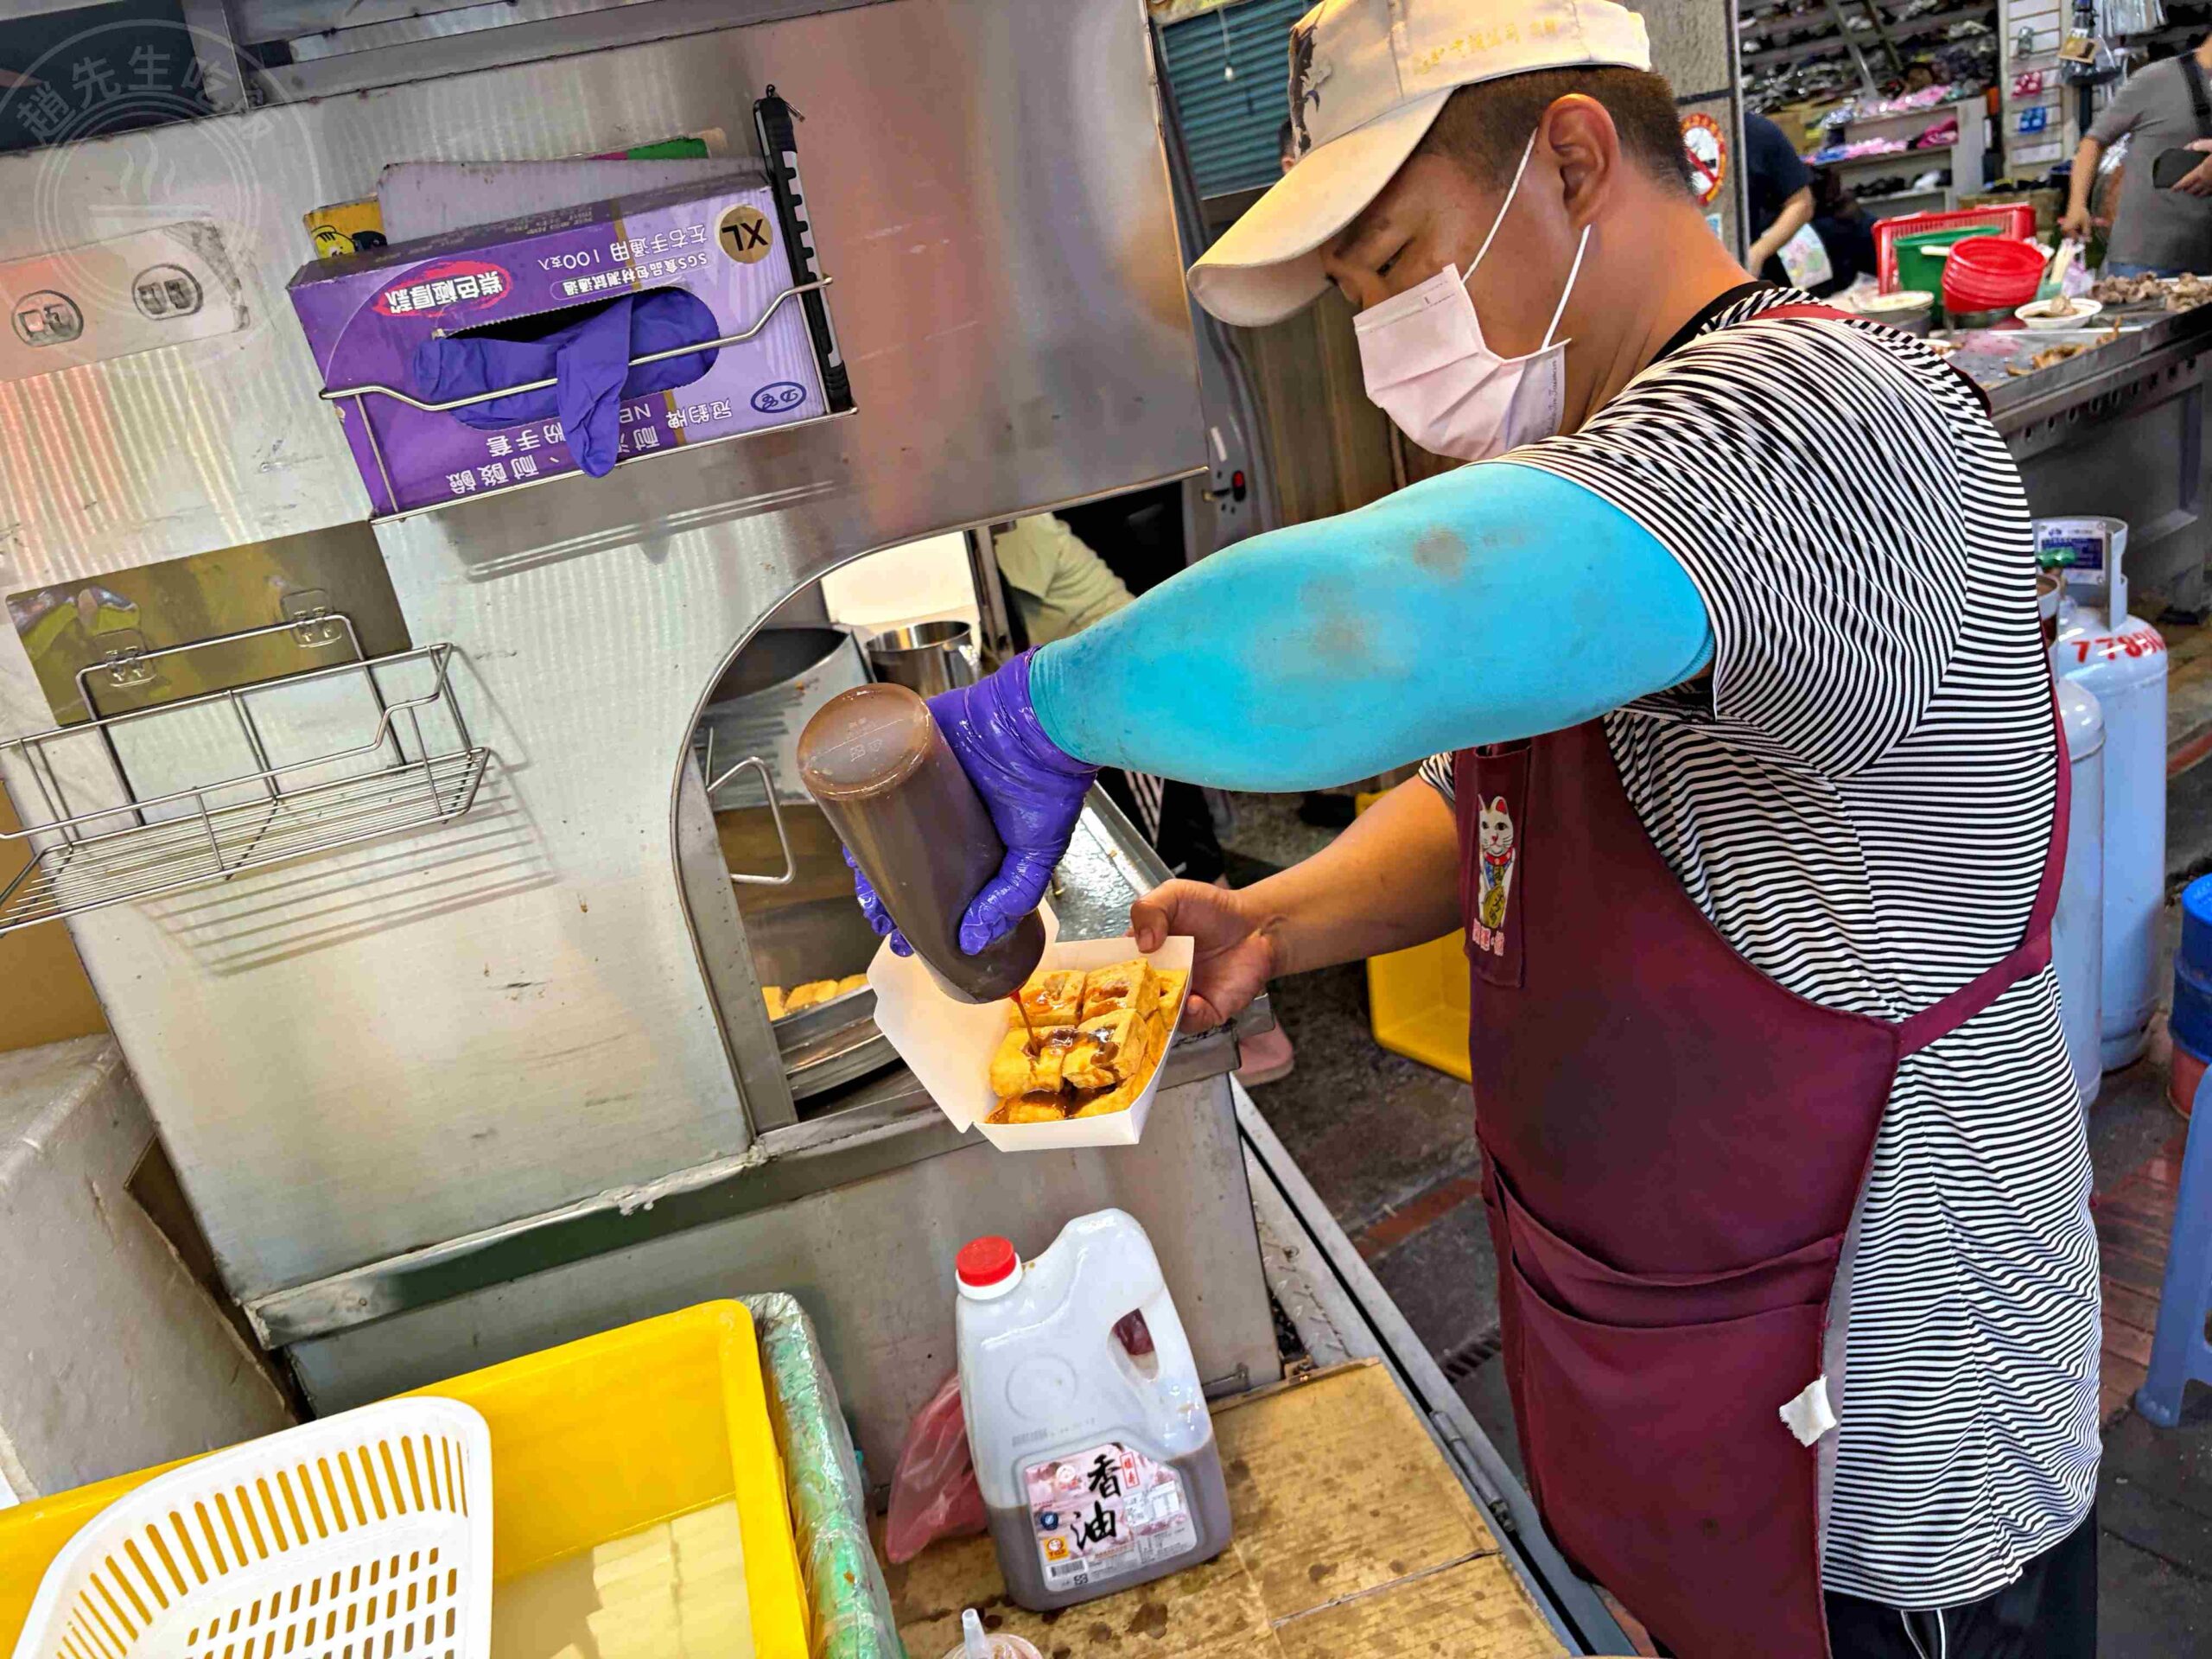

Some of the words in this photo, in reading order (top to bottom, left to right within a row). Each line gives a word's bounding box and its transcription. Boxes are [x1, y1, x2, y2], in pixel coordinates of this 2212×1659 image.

[610, 224, 707, 262] 左右手通用
[722, 217, 770, 252] XL
[537, 249, 600, 271] 100支入
[563, 252, 707, 296] SGS食品包材測試通過
[385, 270, 503, 314] 紫色極厚款
[664, 398, 733, 429] 冠鈞牌
[1071, 1453, 1122, 1550] 香油
